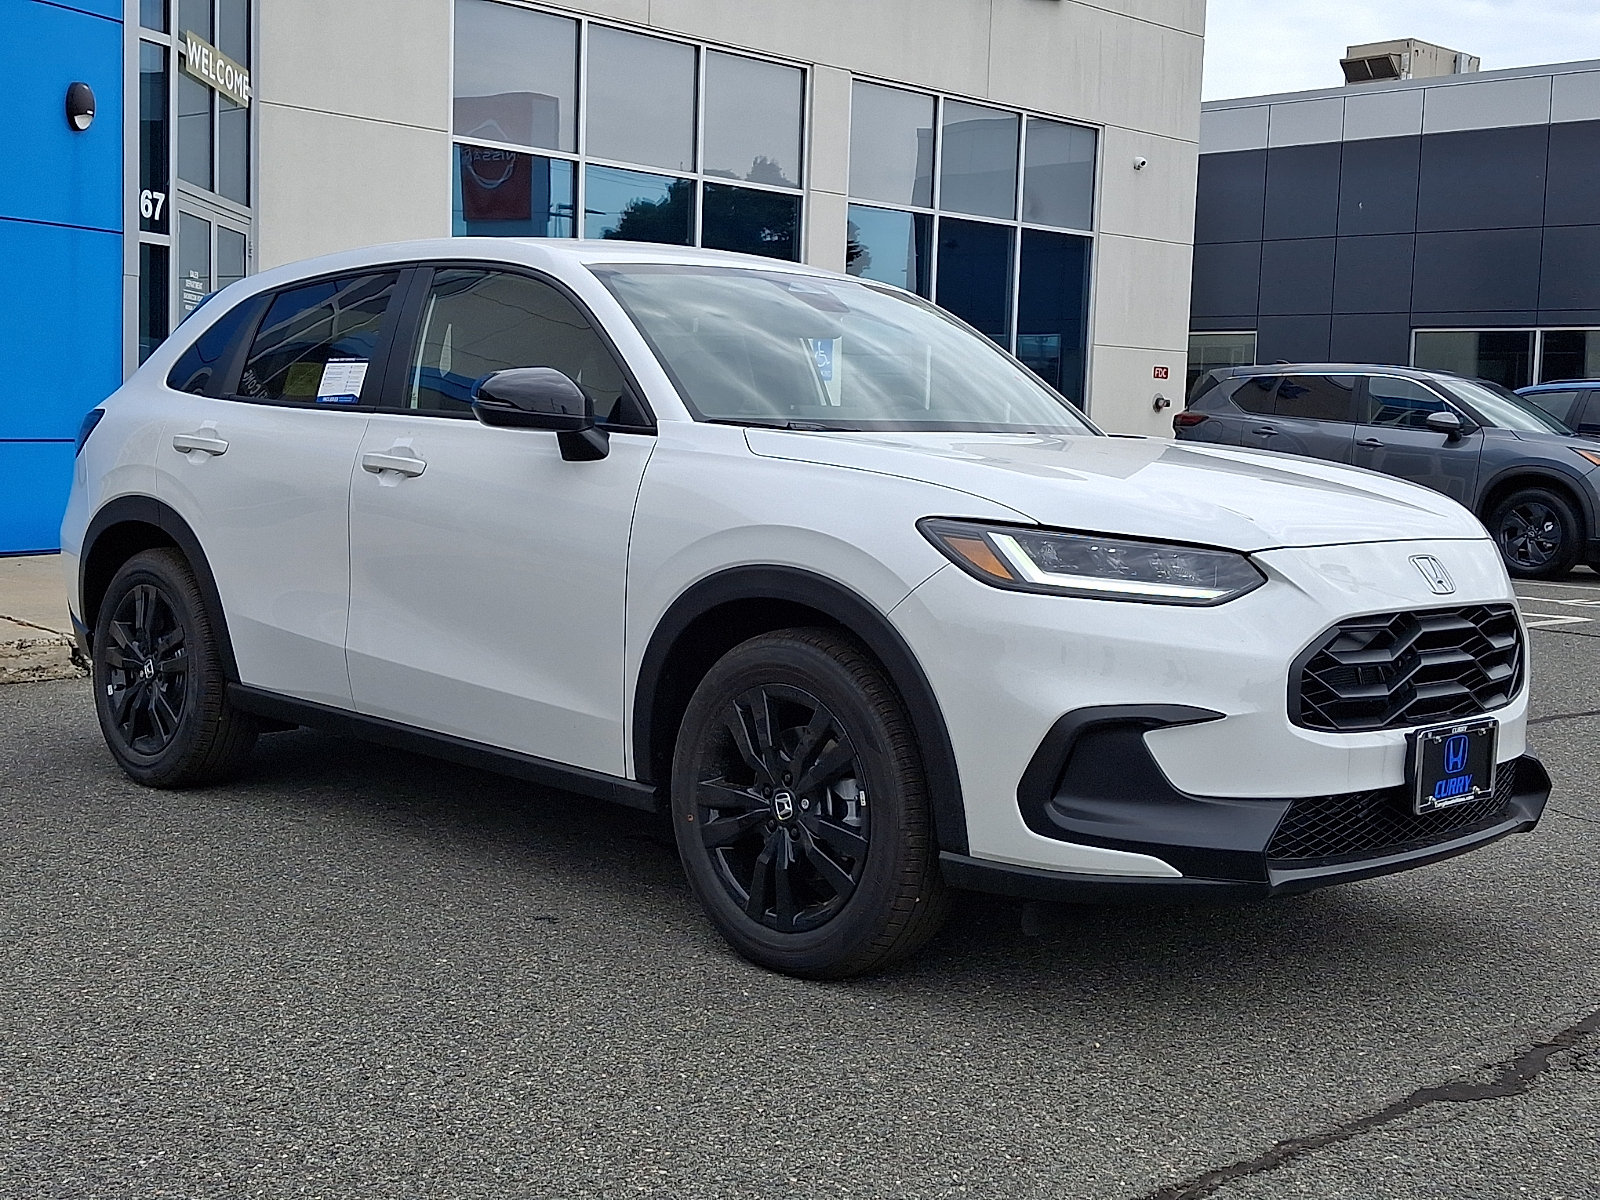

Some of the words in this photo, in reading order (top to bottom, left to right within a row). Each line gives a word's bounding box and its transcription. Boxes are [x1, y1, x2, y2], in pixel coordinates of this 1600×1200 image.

[186, 37, 249, 101] WELCOME
[140, 189, 165, 220] 67
[1154, 367, 1167, 378] FDC
[1434, 774, 1473, 799] CURRY
